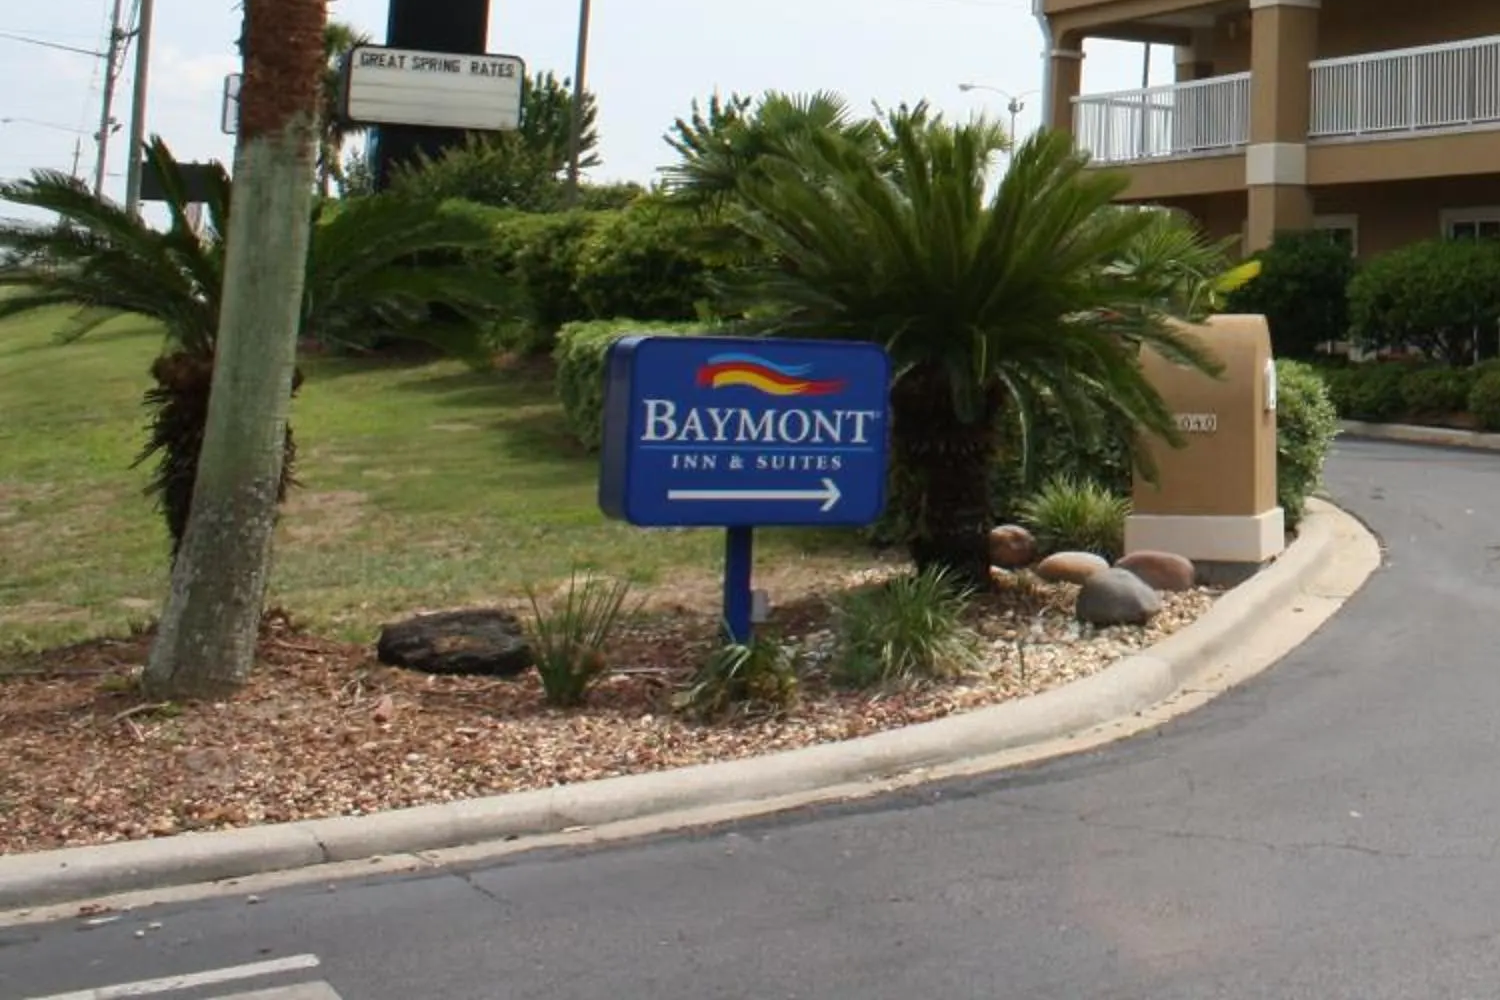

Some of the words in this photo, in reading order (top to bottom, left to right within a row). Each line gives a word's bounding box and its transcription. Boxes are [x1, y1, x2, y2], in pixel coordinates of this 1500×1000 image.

[359, 52, 406, 68] GREAT
[411, 55, 461, 73] SPRING
[470, 61, 515, 78] RATES
[641, 399, 876, 443] BAYMONT
[672, 455, 717, 469] INN
[729, 455, 744, 470] &
[756, 455, 842, 471] SUITES
